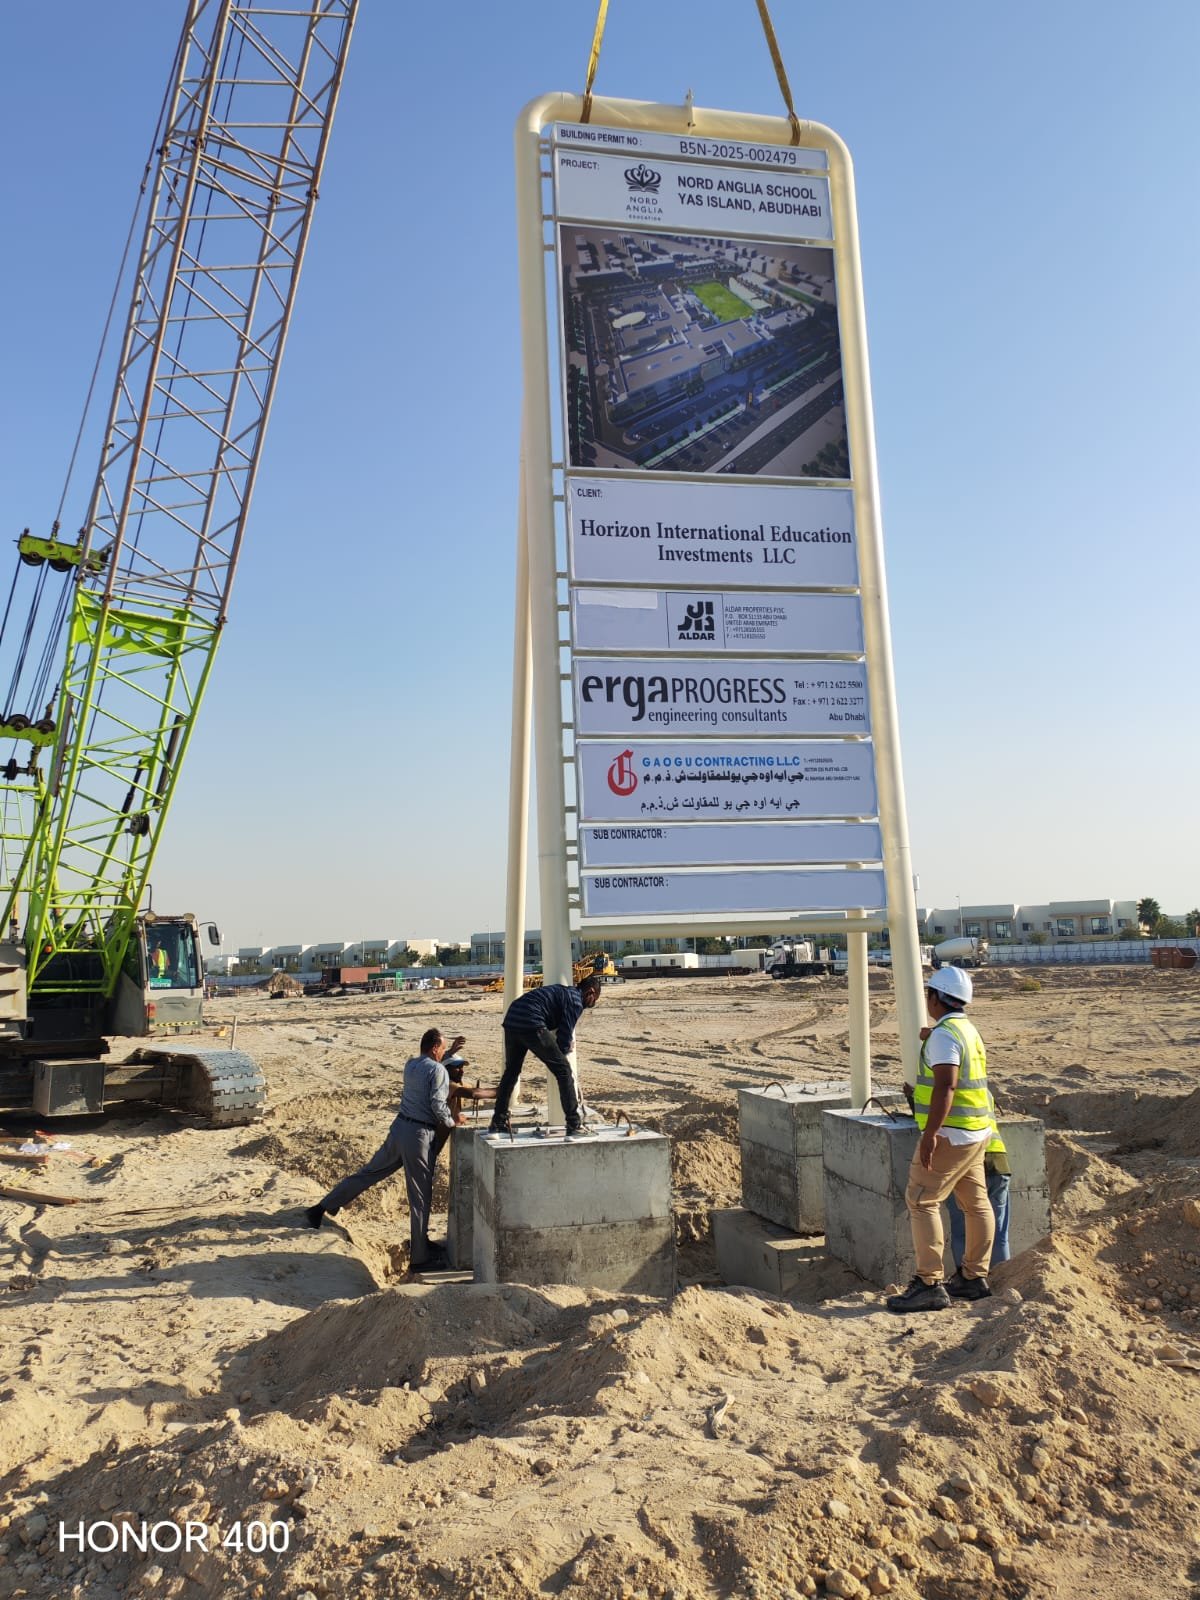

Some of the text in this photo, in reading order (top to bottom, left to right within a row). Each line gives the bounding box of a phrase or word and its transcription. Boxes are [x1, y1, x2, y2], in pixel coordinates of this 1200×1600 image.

[560, 129, 596, 141] BUILDING
[597, 133, 625, 144] PERMIT
[560, 158, 600, 170] PROJECT:
[677, 175, 817, 200] NORD ANGLIA SCHOOL
[629, 196, 658, 206] NORD
[678, 192, 822, 217] YAS ISLAND, ABUDHABI
[626, 205, 663, 214] ANGLIA
[577, 488, 603, 498] CLIENT:
[580, 519, 852, 544] Horizon International Education
[657, 544, 797, 564] Investments LLC
[742, 606, 773, 614] PROPERTIES
[678, 632, 715, 640] ALDAR
[648, 708, 787, 726] engineering consultants
[829, 712, 843, 721] Abu
[694, 756, 775, 767] CONTRACTING
[593, 829, 609, 840] SUB
[610, 828, 663, 840] CONTRACTOR
[594, 878, 611, 889] SUB
[612, 876, 665, 888] CONTRACTOR
